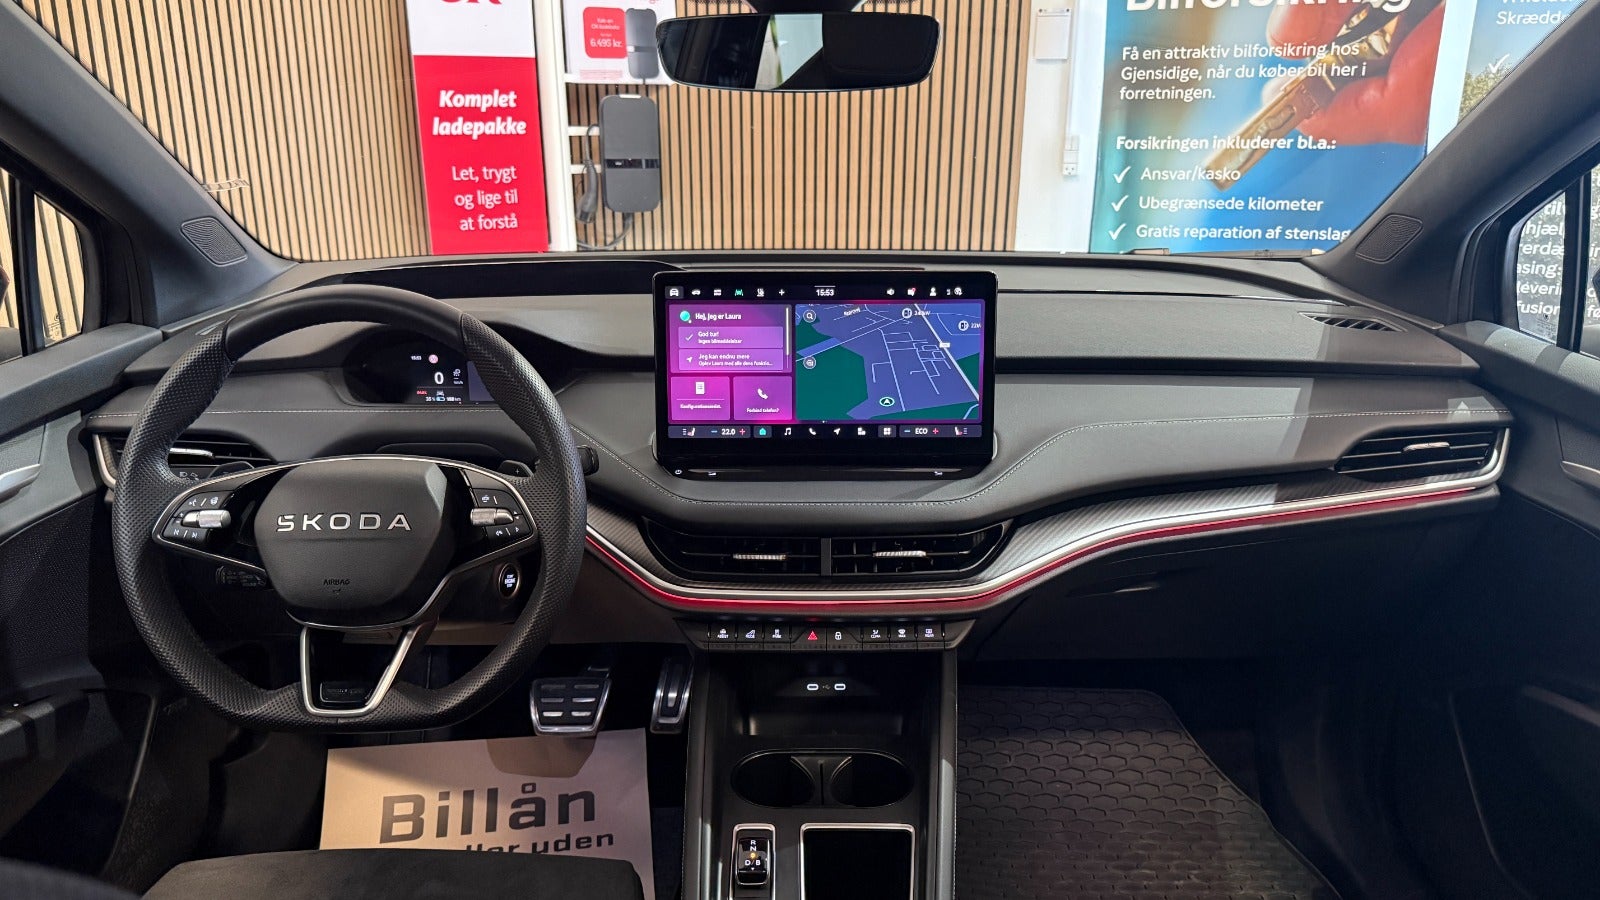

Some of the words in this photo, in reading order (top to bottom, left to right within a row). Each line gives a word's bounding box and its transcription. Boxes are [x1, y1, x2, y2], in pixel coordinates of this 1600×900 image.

[1122, 46, 1139, 61] Få
[1142, 48, 1161, 60] en
[1164, 45, 1230, 59] attraktiv
[1233, 42, 1326, 59] bilforsikring
[1331, 42, 1360, 56] hos
[1121, 66, 1202, 83] Gjensidige,
[1206, 64, 1232, 79] når
[1235, 64, 1255, 78] du
[1258, 63, 1302, 78] køber
[1307, 63, 1327, 77] bil
[1331, 62, 1358, 77] her
[1361, 62, 1367, 76] i
[439, 89, 517, 112] Komplet
[1119, 87, 1216, 103] forretningen.
[432, 117, 527, 140] ladepakke
[1116, 136, 1209, 151] Forsikringen
[1212, 135, 1294, 150] inkluderer
[1297, 135, 1337, 150] bl.a.:
[452, 166, 479, 183] Let,
[482, 165, 518, 184] trygt
[1140, 166, 1241, 182] Ansvar/kasko
[454, 194, 475, 210] og
[477, 190, 502, 209] lige
[504, 189, 519, 205] til
[1138, 196, 1245, 213] Ubegrænsede
[1247, 197, 1324, 212] kilometer
[459, 217, 475, 231] at
[478, 213, 519, 230] forstå
[1136, 224, 1180, 239] Gratis
[1183, 225, 1261, 242] reparation
[1264, 225, 1282, 239] af
[816, 288, 834, 296] 15:53
[434, 371, 444, 385] 0
[915, 427, 928, 435] ECO
[276, 512, 411, 532] SKODA
[379, 782, 596, 844] Billån
[531, 832, 614, 855] uden
